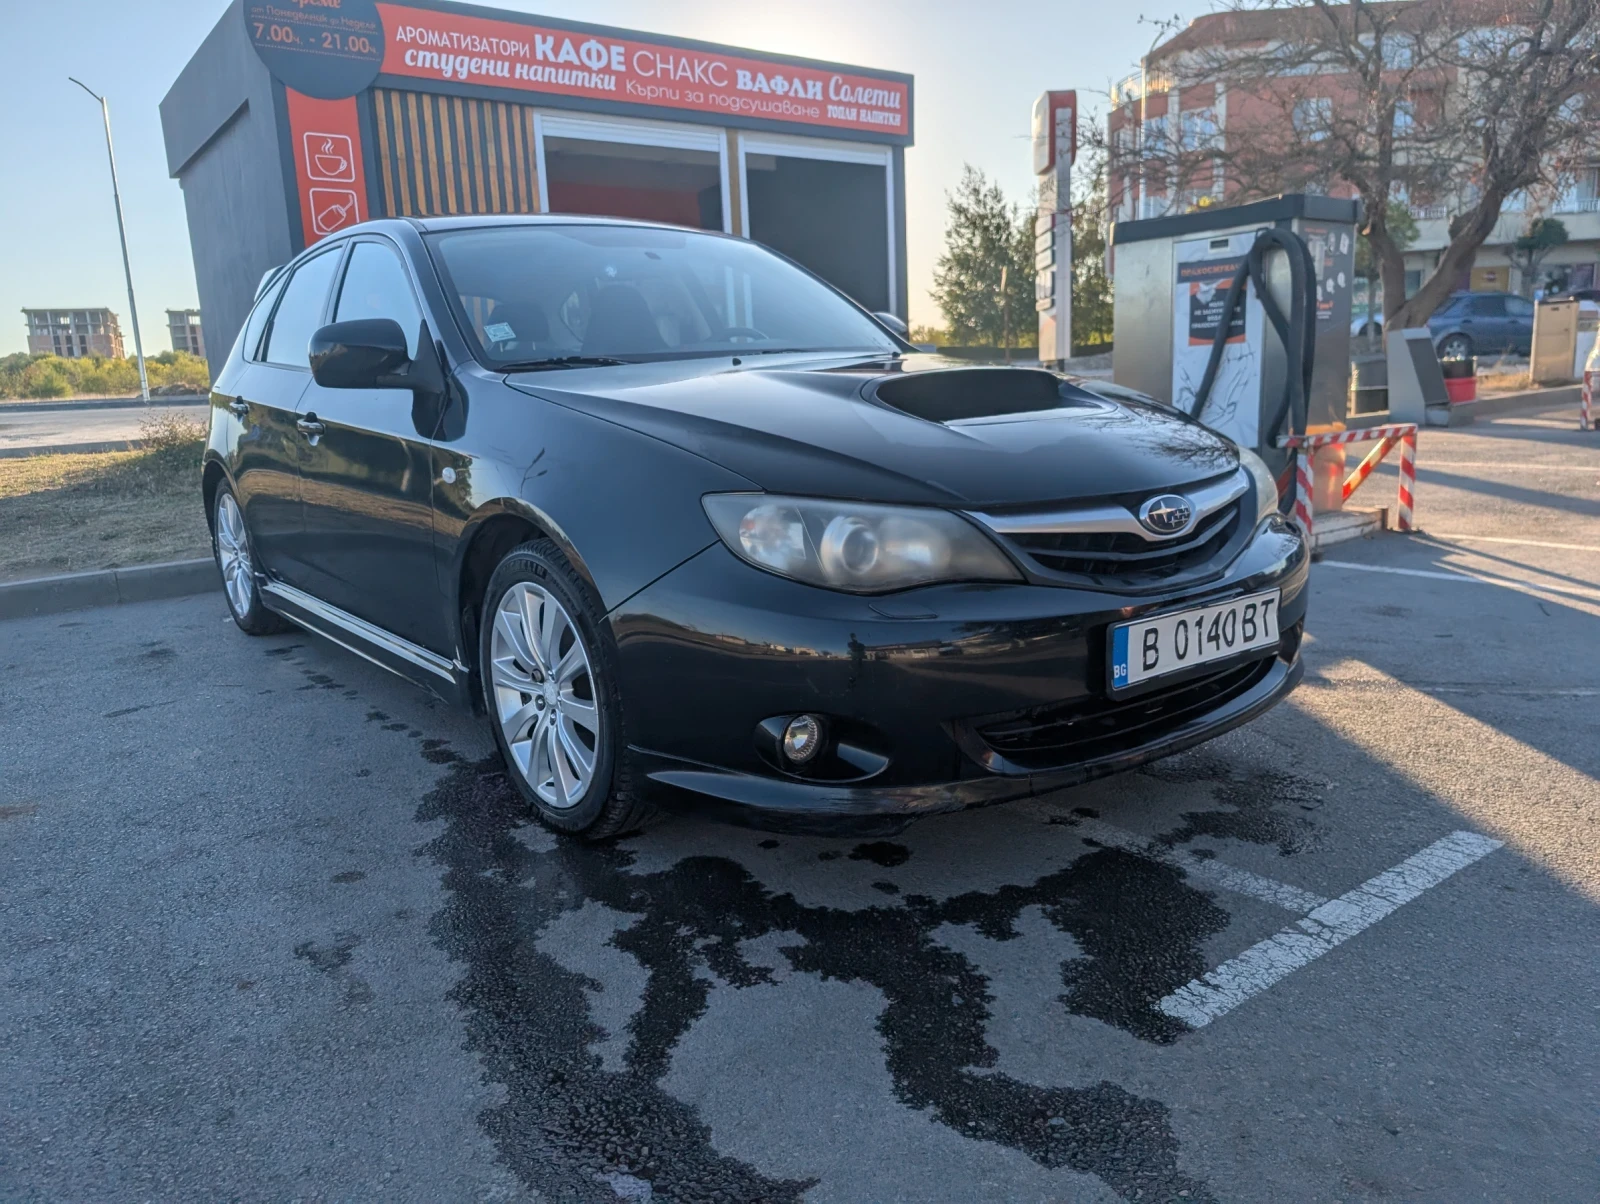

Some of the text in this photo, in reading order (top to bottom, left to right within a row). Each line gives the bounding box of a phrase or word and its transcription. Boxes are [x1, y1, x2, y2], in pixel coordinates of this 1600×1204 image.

[266, 4, 327, 22] Понеделник
[340, 15, 376, 30] Неделя
[396, 26, 901, 109] АРОМАТИЗАТОРИ КАФЕ СНАКС ВАФЛИ Солети
[404, 49, 510, 80] студени
[514, 62, 616, 91] напитки
[626, 79, 680, 100] Кърпи
[685, 90, 704, 103] за
[708, 94, 820, 118] подсушаване
[1113, 664, 1127, 678] BG
[1142, 627, 1159, 672] B
